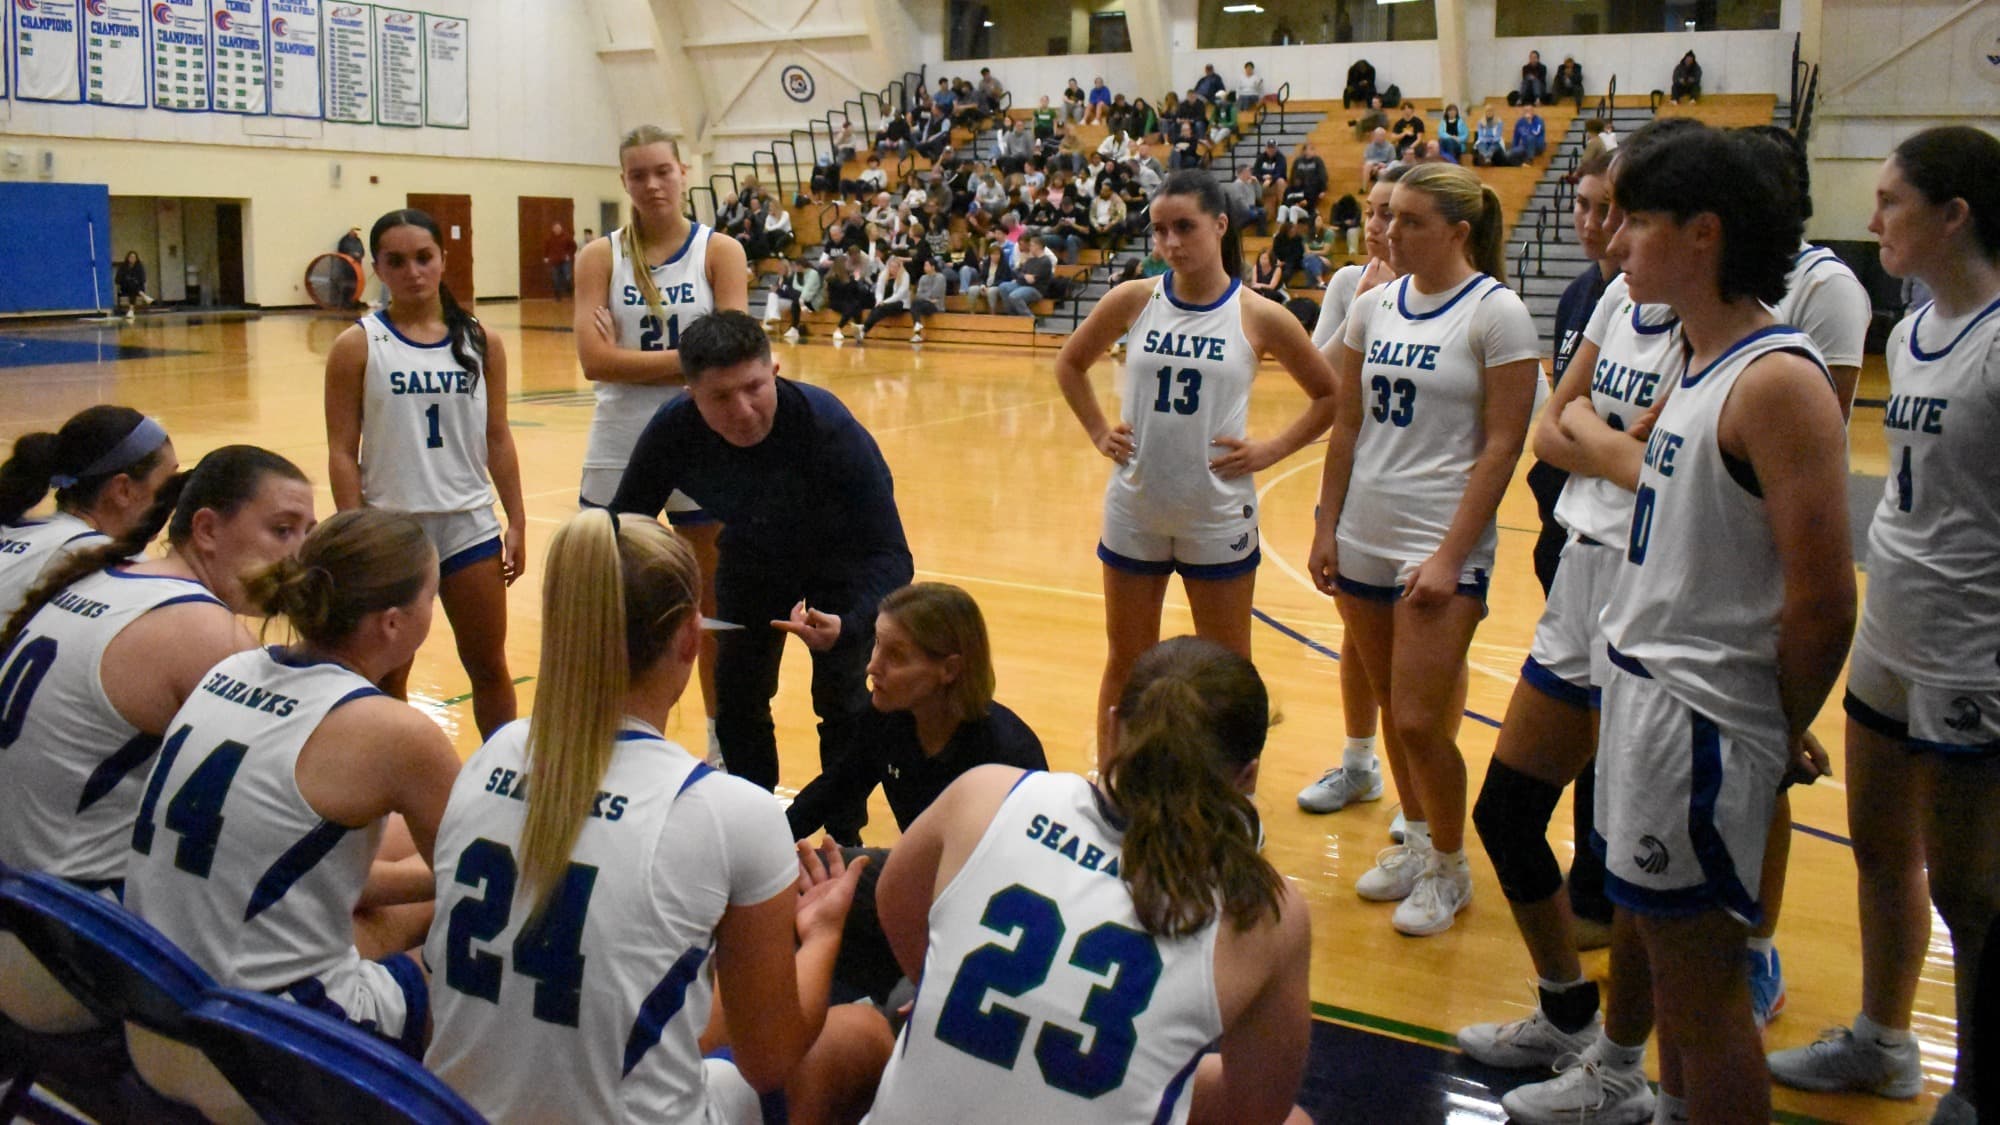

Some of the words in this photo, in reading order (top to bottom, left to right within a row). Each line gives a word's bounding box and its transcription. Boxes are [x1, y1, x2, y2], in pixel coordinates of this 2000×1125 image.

[20, 15, 73, 32] CHAMPIONS
[90, 21, 140, 38] CHAMPIONS
[157, 29, 204, 46] CHAMPIONS
[218, 35, 260, 51] CHAMPIONS
[274, 41, 316, 56] CHAMPIONS
[623, 282, 695, 306] SVE
[640, 313, 681, 352] 21
[1143, 329, 1226, 362] SALVE
[1366, 340, 1441, 371] SALVE
[390, 370, 470, 395] SALVE
[1154, 365, 1203, 416] 13
[1370, 374, 1417, 428] 33
[1592, 358, 1661, 408] SALVE
[425, 403, 444, 449] 1
[1884, 394, 1948, 435] ALVE
[1628, 482, 1656, 567] 0
[0, 622, 58, 749] 0
[202, 672, 299, 718] SEAHAWKS
[131, 723, 250, 880] 14
[485, 766, 629, 822] SEAKS
[1026, 814, 1121, 878] SEAHA
[446, 837, 600, 1029] 24
[934, 883, 1164, 1100] 23
